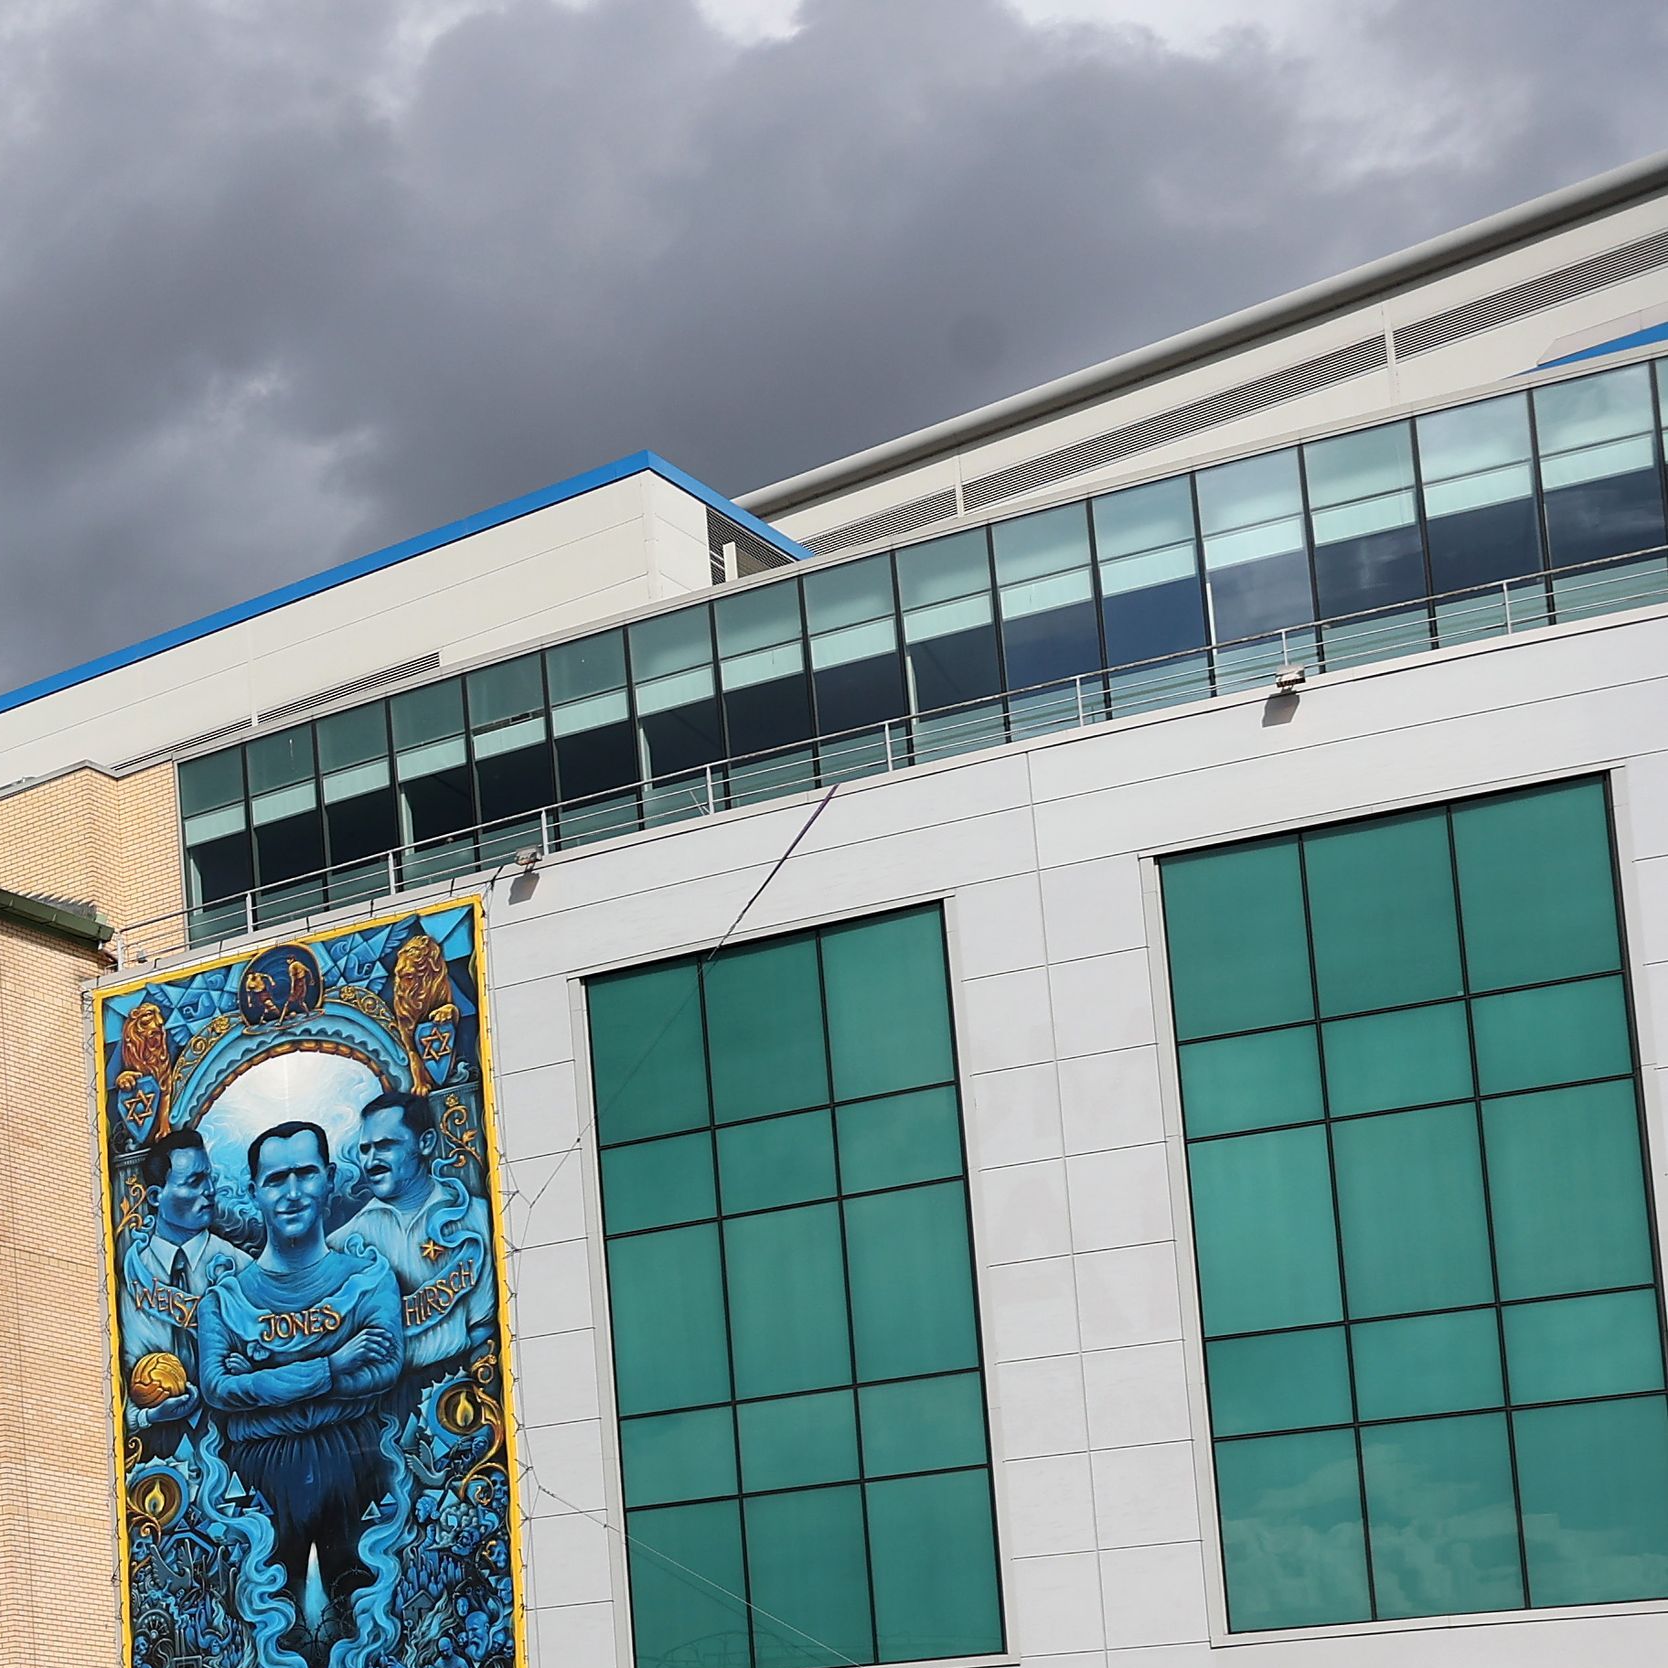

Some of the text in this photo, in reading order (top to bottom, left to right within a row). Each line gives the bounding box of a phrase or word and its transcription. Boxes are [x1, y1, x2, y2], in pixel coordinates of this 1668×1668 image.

[132, 1276, 200, 1328] WEISZ
[402, 1259, 476, 1328] HIRSCH
[258, 1303, 342, 1343] JONES
